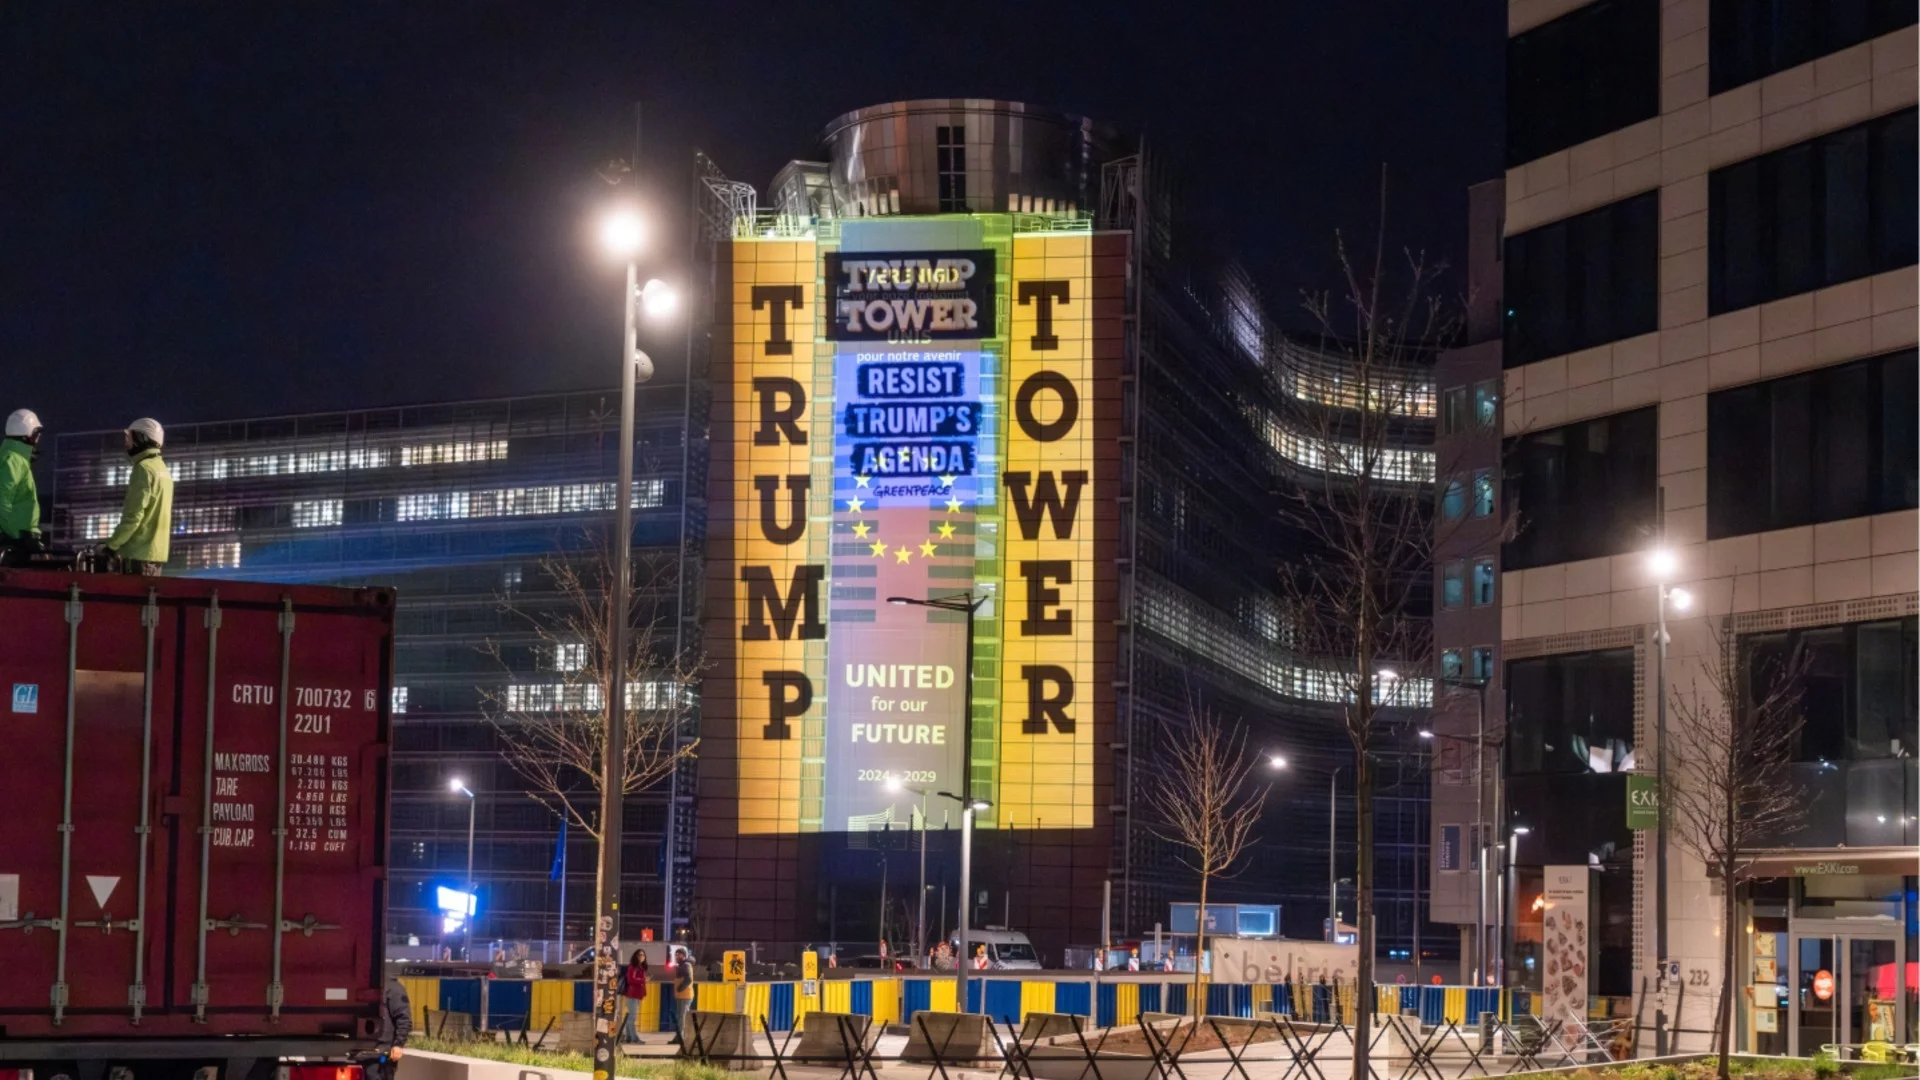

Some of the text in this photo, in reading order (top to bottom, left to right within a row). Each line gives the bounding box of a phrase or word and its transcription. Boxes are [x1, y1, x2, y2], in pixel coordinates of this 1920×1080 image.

[842, 258, 976, 291] TRUMP
[840, 299, 978, 332] TOWER
[856, 349, 961, 364] pour notre avenir
[868, 367, 956, 394] RESIST
[854, 405, 972, 434] TRUMP'S
[861, 446, 965, 474] AGENDA
[872, 484, 950, 498] GREENPEACE
[741, 285, 825, 740] TRUMP
[1003, 280, 1088, 735] TOWER
[846, 664, 954, 689] UNITED
[232, 684, 376, 711] CRTU 700732 6
[871, 696, 928, 712] for our
[294, 713, 331, 734] 22U1
[851, 723, 946, 745] FUTURE
[214, 752, 270, 773] MAXGROSS
[331, 755, 348, 767] KGS
[858, 769, 937, 783] 2024 2029
[215, 777, 239, 797] TARE
[331, 780, 349, 791] KGS
[213, 802, 254, 821] PAYLOAD
[329, 804, 347, 815] KGS
[295, 828, 317, 840] 32.5
[328, 829, 347, 840] CUM
[1689, 970, 1709, 986] 232
